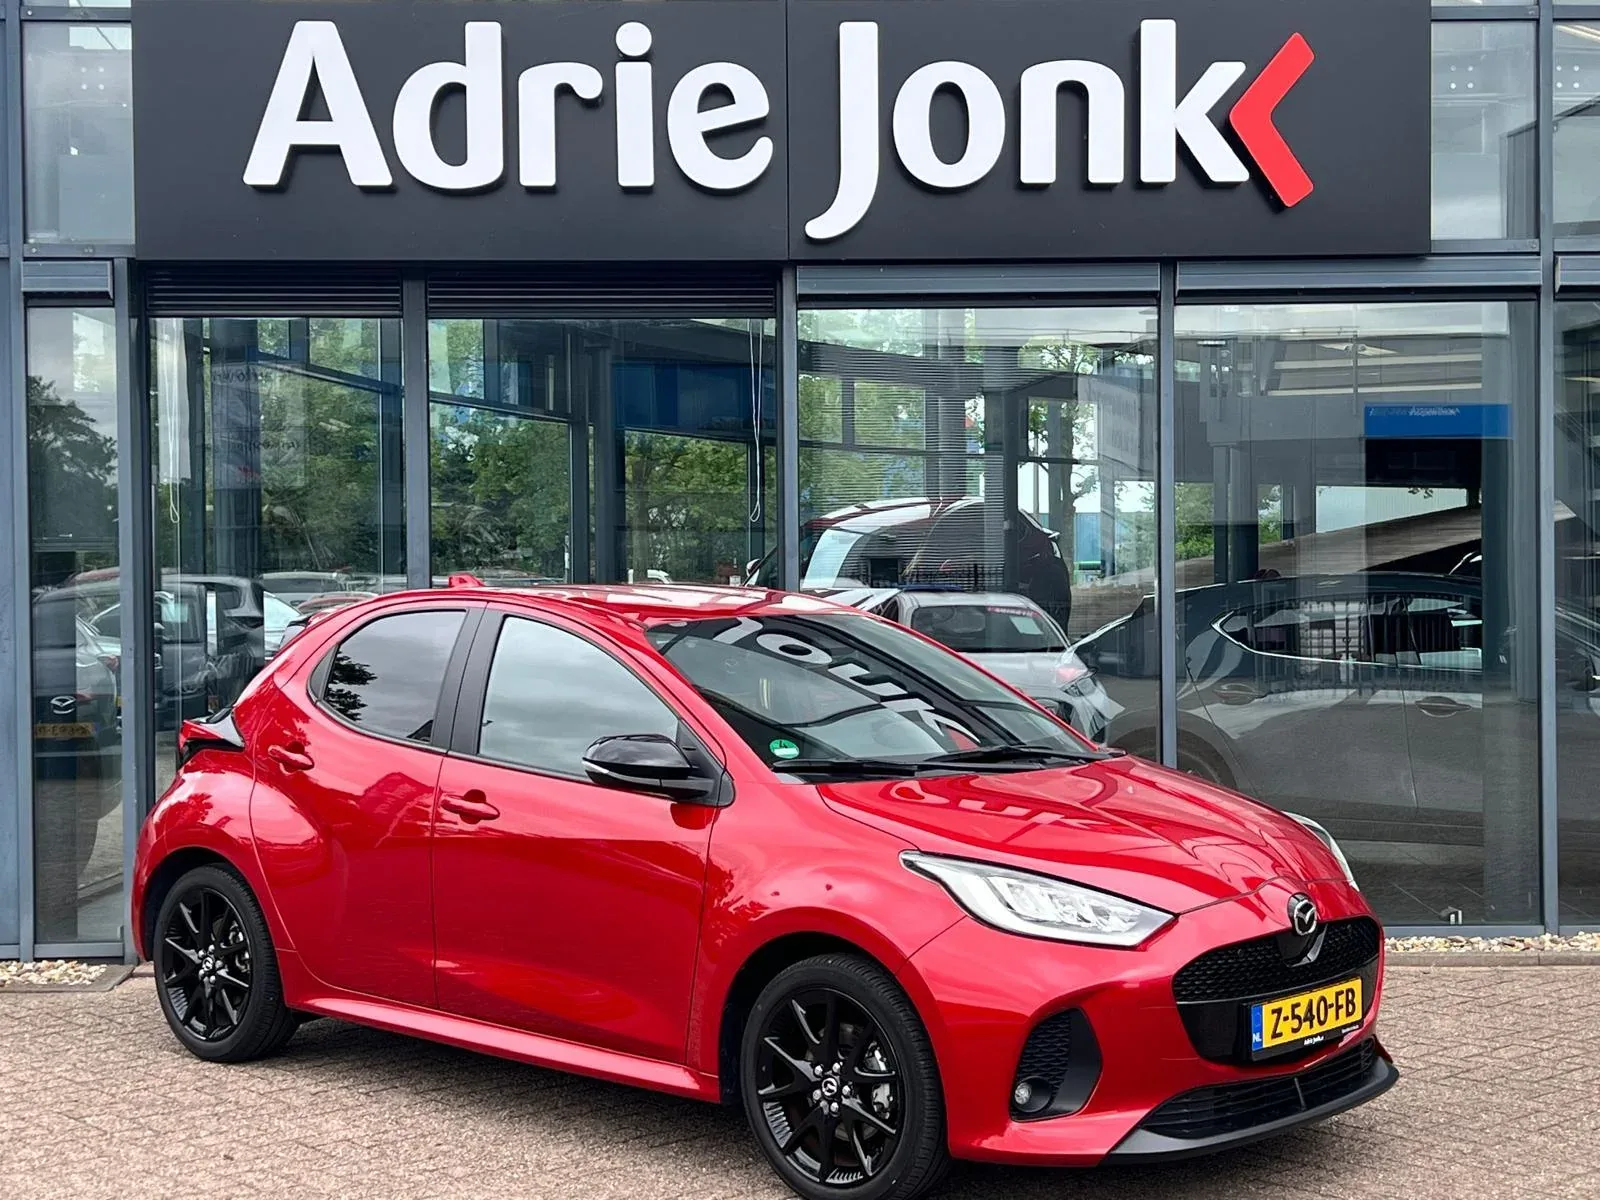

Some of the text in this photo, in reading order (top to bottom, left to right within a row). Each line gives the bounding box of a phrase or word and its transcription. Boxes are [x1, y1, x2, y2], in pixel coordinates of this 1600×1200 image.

[243, 19, 1250, 240] Adrie Jonk
[1253, 1032, 1262, 1043] NL
[1271, 987, 1356, 1040] Z-540-FB
